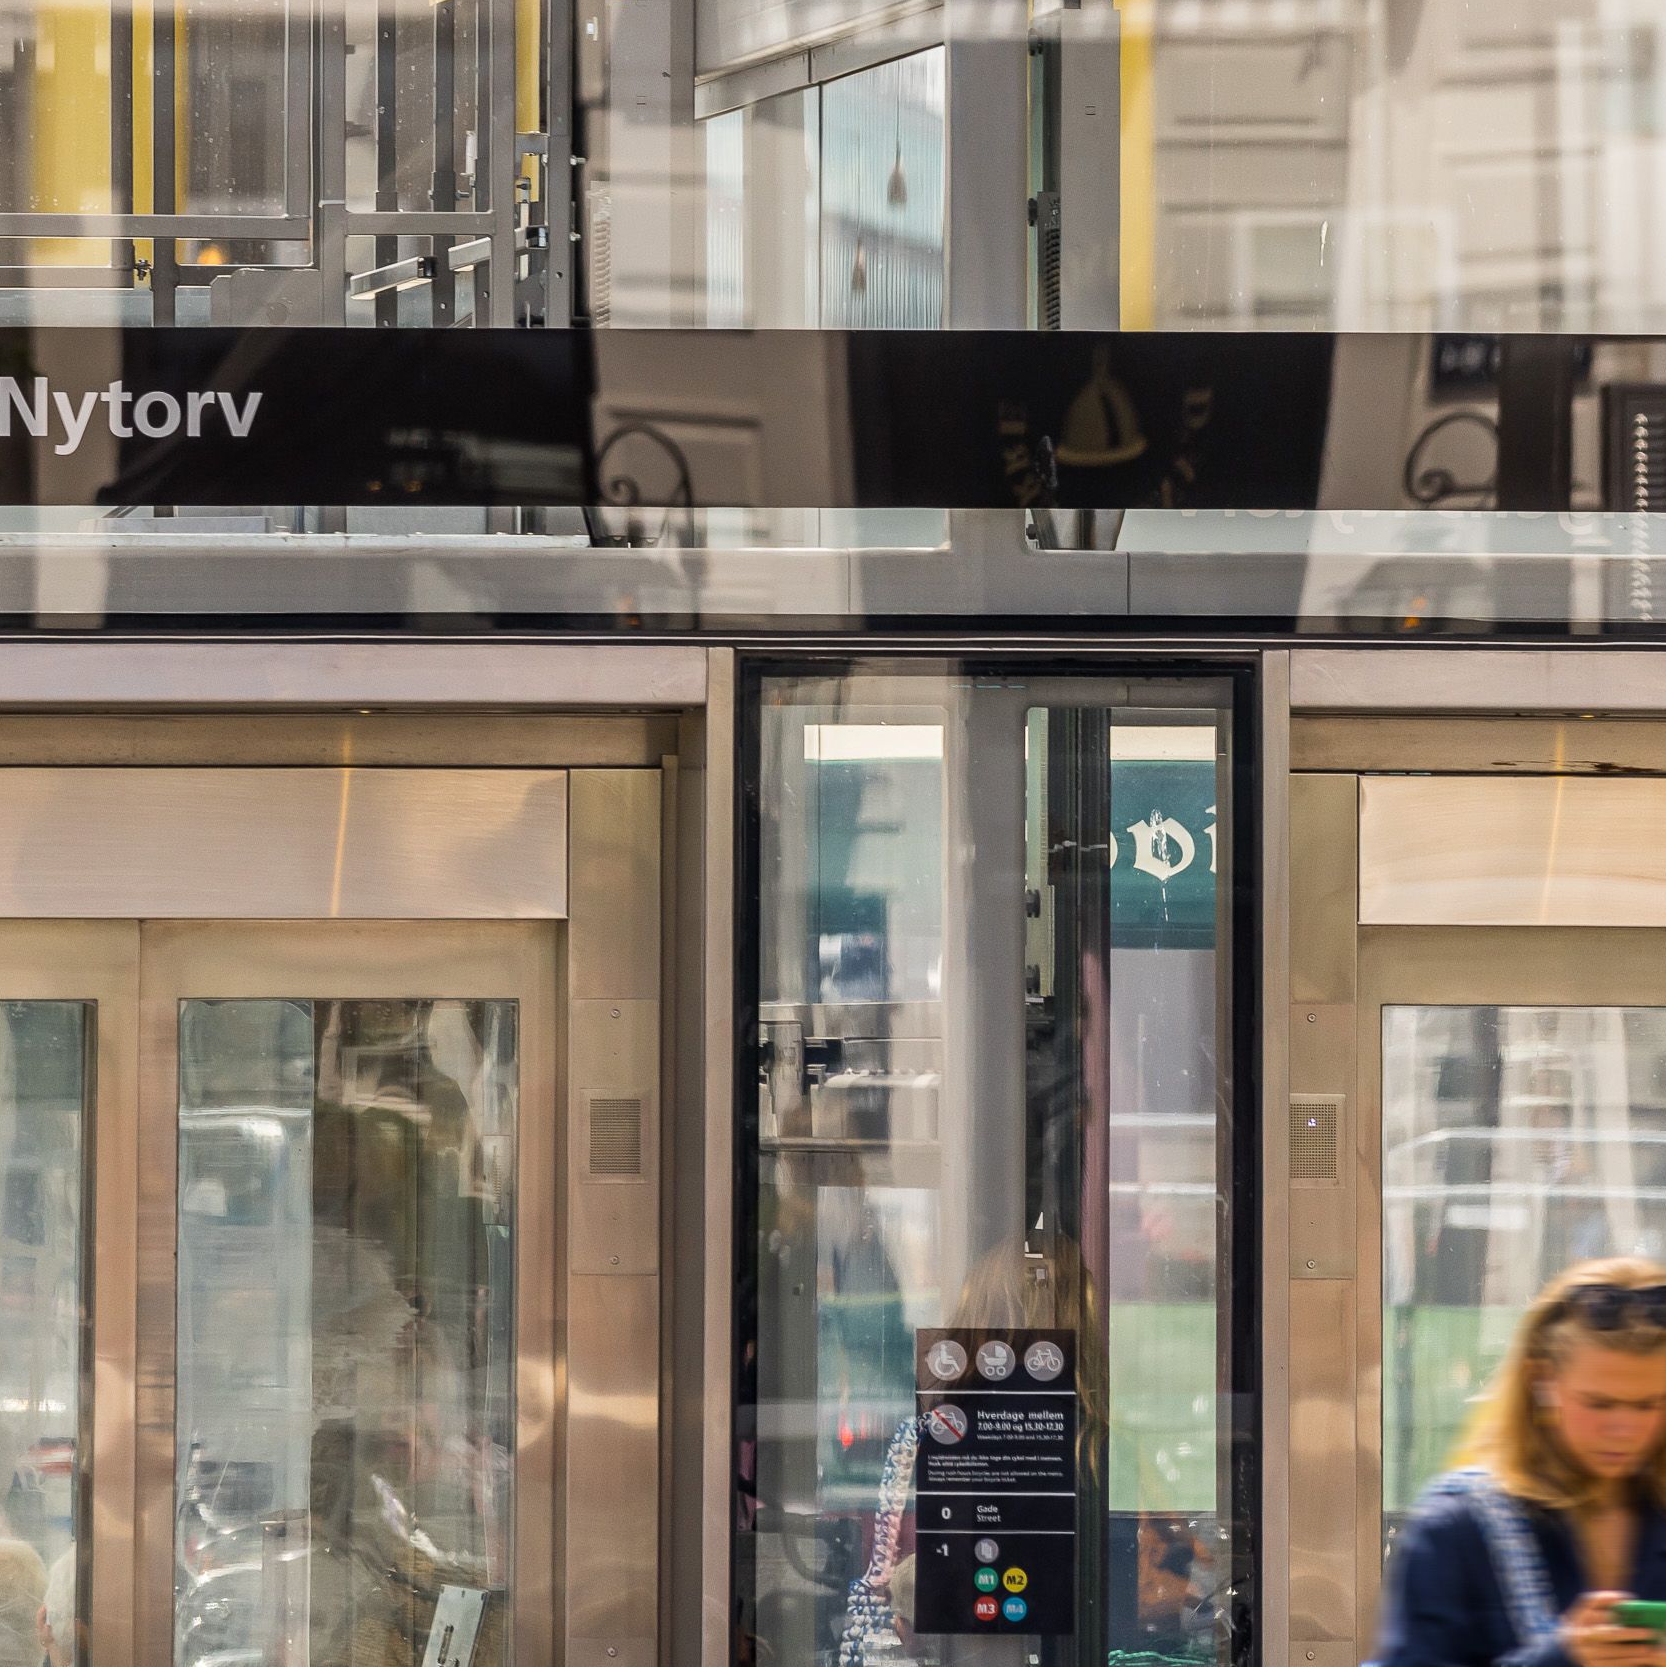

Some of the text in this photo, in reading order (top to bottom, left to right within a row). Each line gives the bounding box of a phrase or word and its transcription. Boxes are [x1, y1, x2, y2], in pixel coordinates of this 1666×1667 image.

[977, 1409, 1064, 1422] Hverdage mellem
[1012, 1423, 1023, 1433] og
[941, 1505, 998, 1520] 0 Gade
[976, 1514, 1001, 1522] Street
[936, 1543, 949, 1557] -1
[978, 1575, 1024, 1586] M1 M2
[977, 1603, 996, 1615] M3
